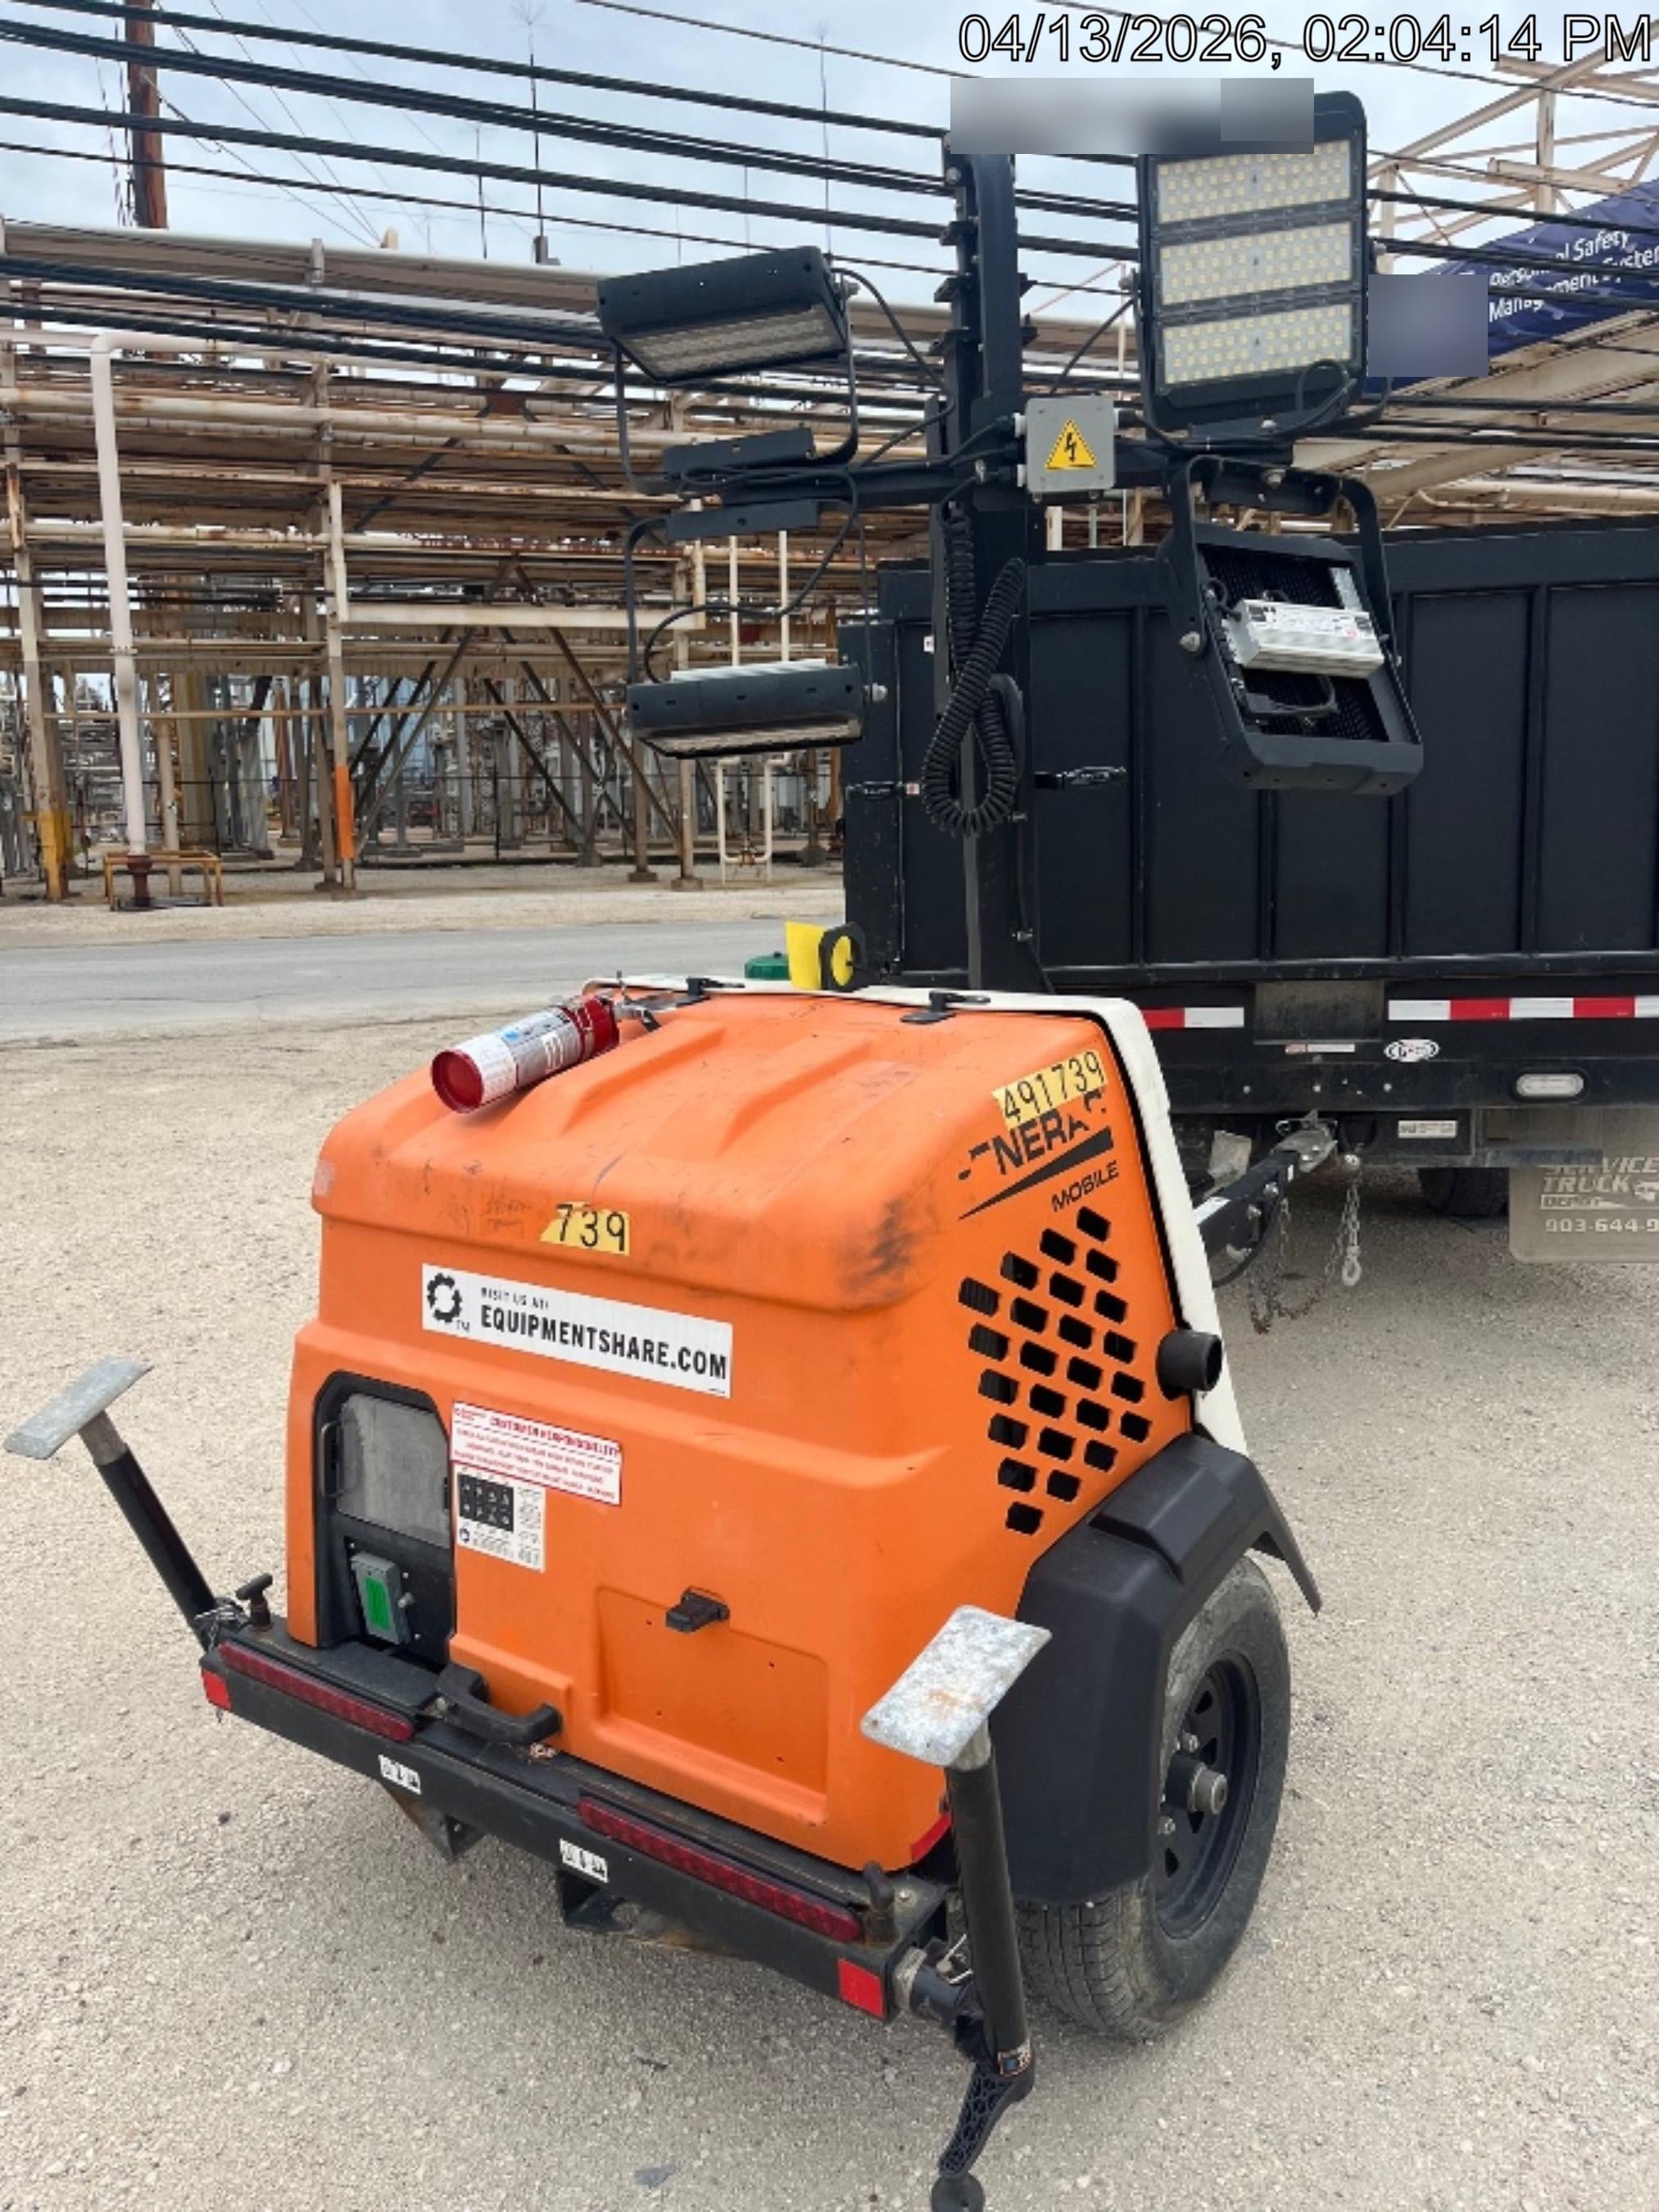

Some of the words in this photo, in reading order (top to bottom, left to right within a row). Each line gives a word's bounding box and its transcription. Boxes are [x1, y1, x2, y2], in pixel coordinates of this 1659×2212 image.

[1004, 1051, 1105, 1122] 491739
[1052, 1160, 1120, 1213] MOBILE
[1543, 1175, 1631, 1194] TRUCK
[556, 1203, 625, 1252] 739
[481, 1304, 727, 1380] EQUIPMENTSHARE.COM
